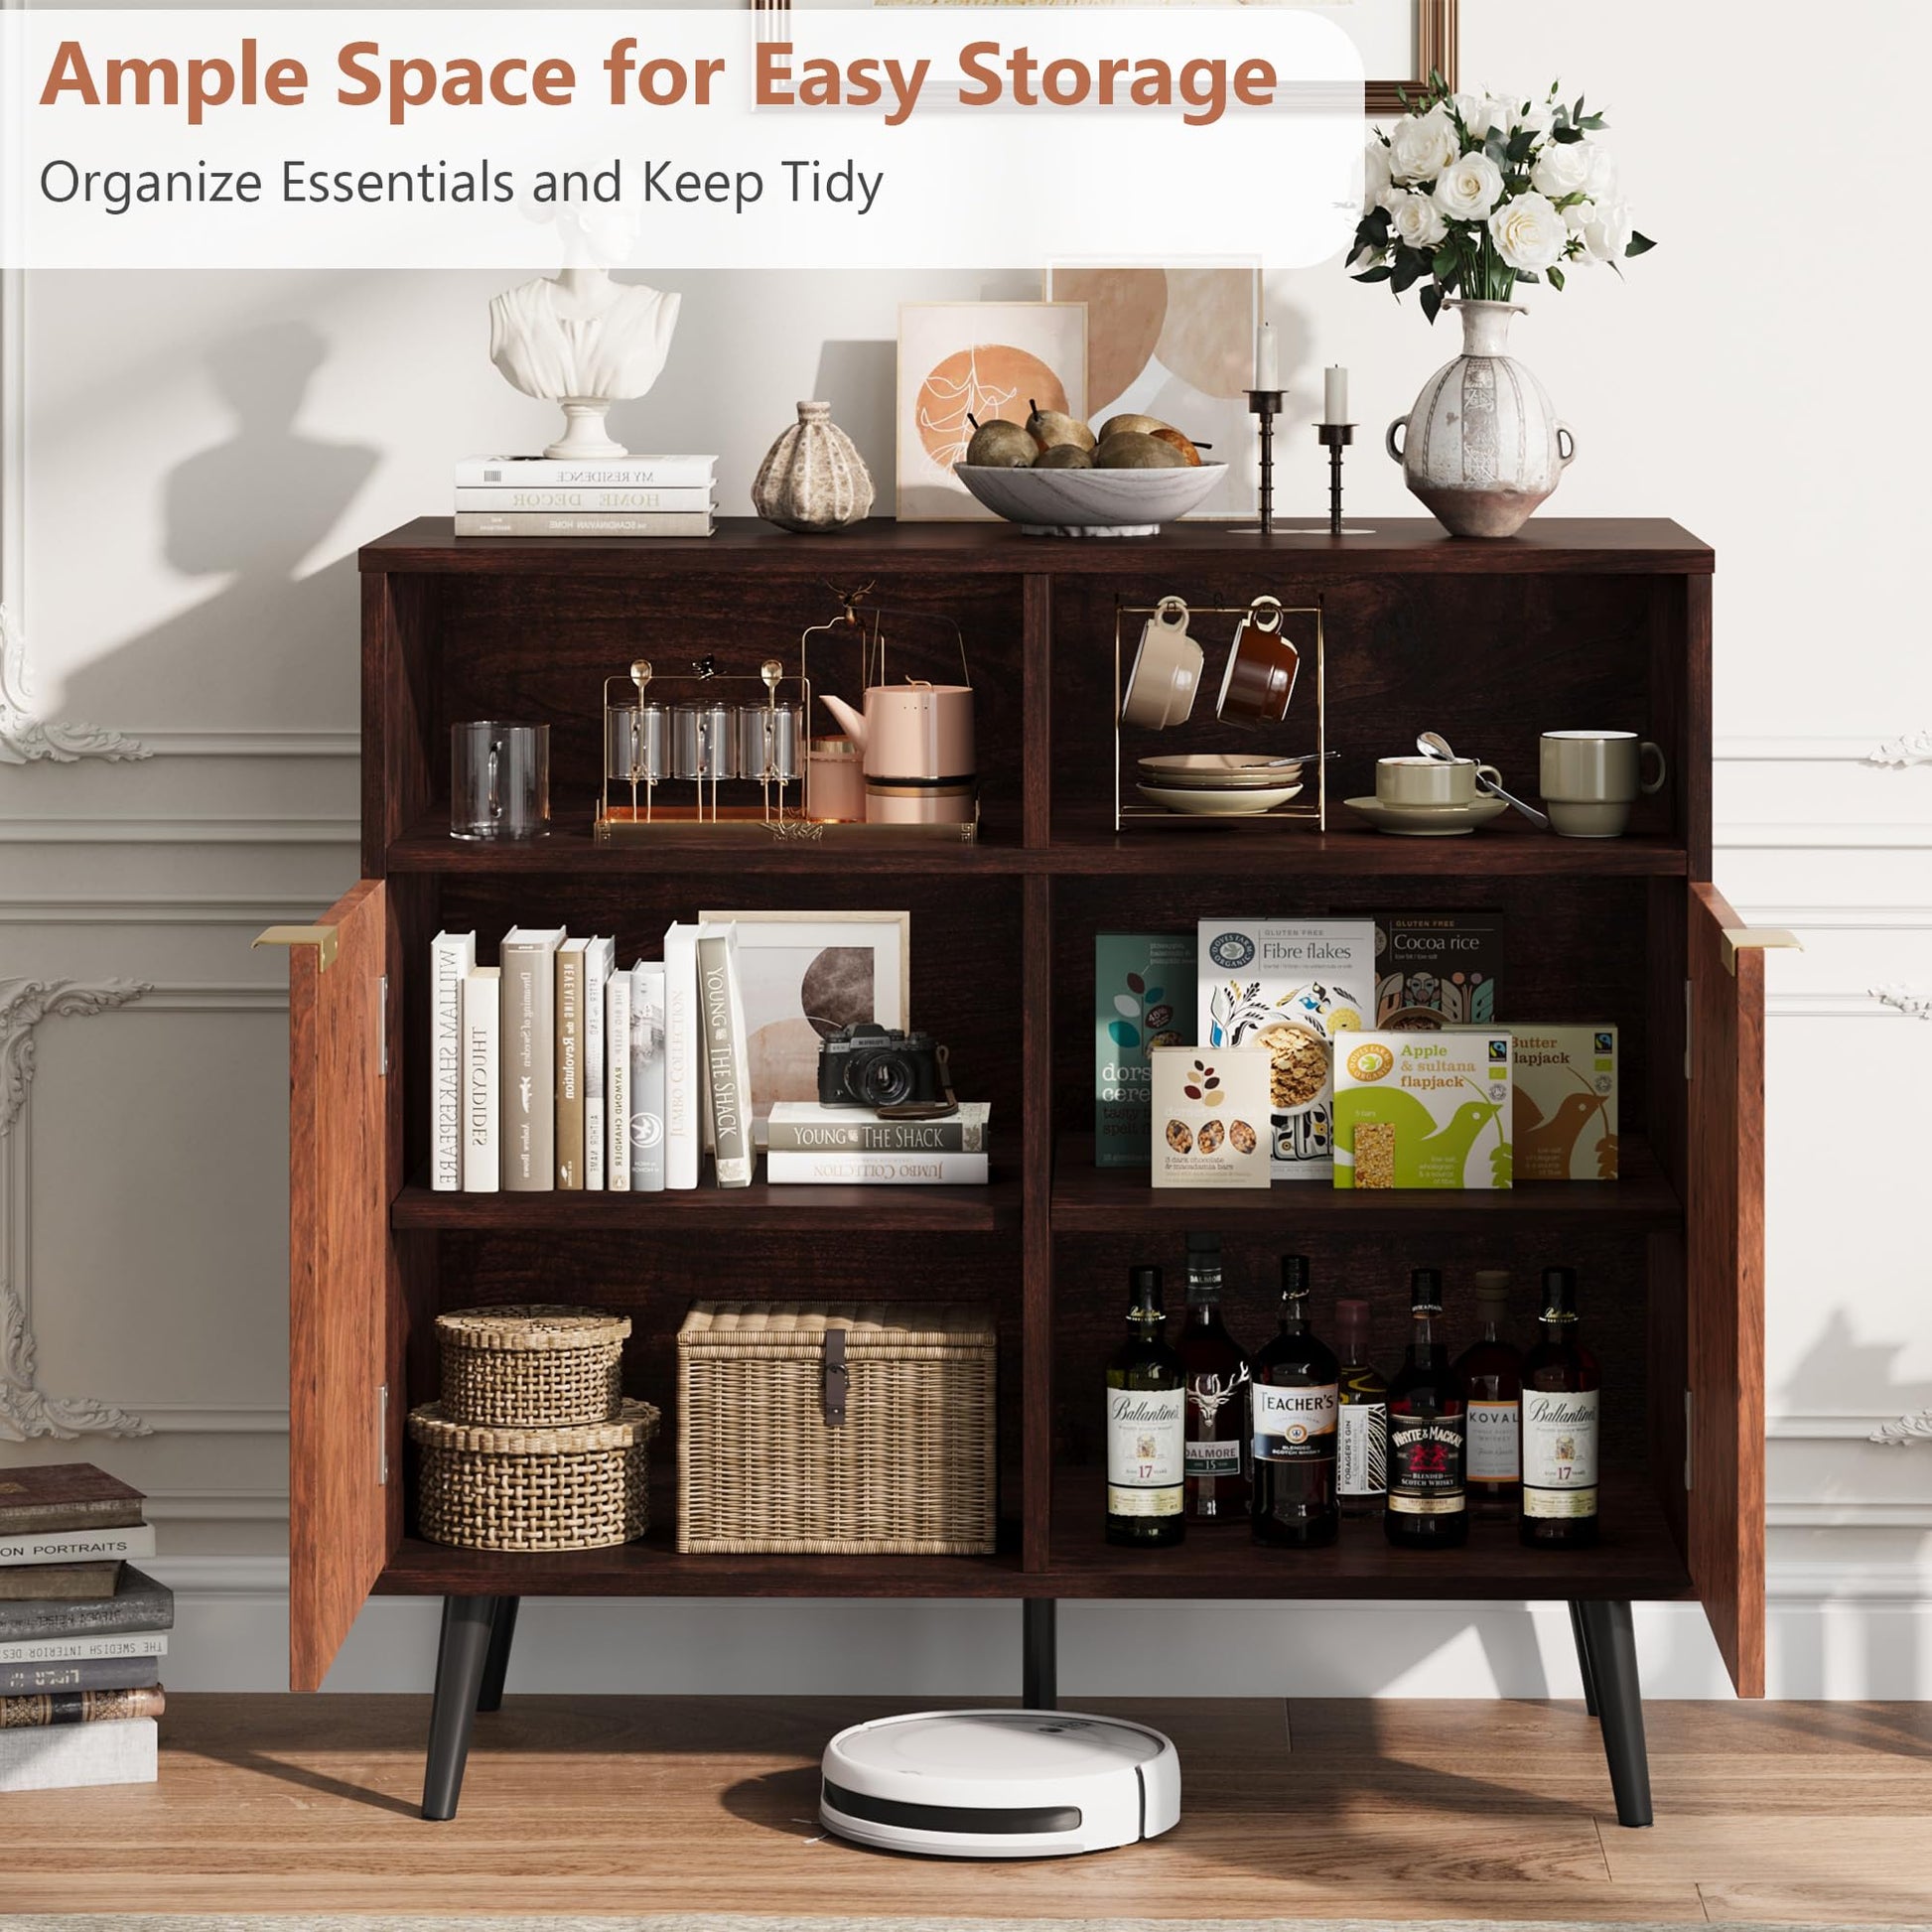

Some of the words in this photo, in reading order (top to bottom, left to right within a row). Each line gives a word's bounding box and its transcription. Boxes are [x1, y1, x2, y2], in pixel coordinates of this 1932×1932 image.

[1394, 934, 1446, 950] Cocoa
[1450, 934, 1479, 950] rice
[1263, 943, 1303, 959] Fibre
[1307, 943, 1351, 959] flakes
[1214, 954, 1251, 968] ORGANIC
[706, 967, 728, 1028] YOUNG
[1512, 1036, 1558, 1048] Butter
[1401, 1044, 1448, 1059] Apple
[710, 1043, 732, 1077] THE
[1401, 1060, 1413, 1072] &
[1417, 1060, 1475, 1072] sultana
[1514, 1052, 1570, 1066] lapjack
[1102, 1063, 1152, 1081] dors
[1400, 1076, 1464, 1090] flapjack
[1102, 1087, 1152, 1102] cere
[714, 1081, 737, 1138] SHACK
[793, 1127, 846, 1145] YOUNG
[862, 1126, 892, 1148] THE
[896, 1126, 944, 1148] SHACK
[899, 1161, 943, 1179] JUMBO
[1261, 1392, 1334, 1413] TEACHER'S
[1469, 1412, 1520, 1424] KOVAL
[1392, 1429, 1423, 1448] WHYTE
[1422, 1430, 1429, 1440] &
[1429, 1426, 1463, 1449] MACKAY
[1185, 1448, 1236, 1458] DALMORE
[1205, 1459, 1216, 1469] 15
[1139, 1465, 1153, 1478] 17
[1558, 1466, 1573, 1480] 17
[33, 1541, 128, 1556] PORTRAITS
[29, 1645, 81, 1657] INTERIOR
[89, 1642, 136, 1655] SWEDISH
[143, 1641, 163, 1653] THE
